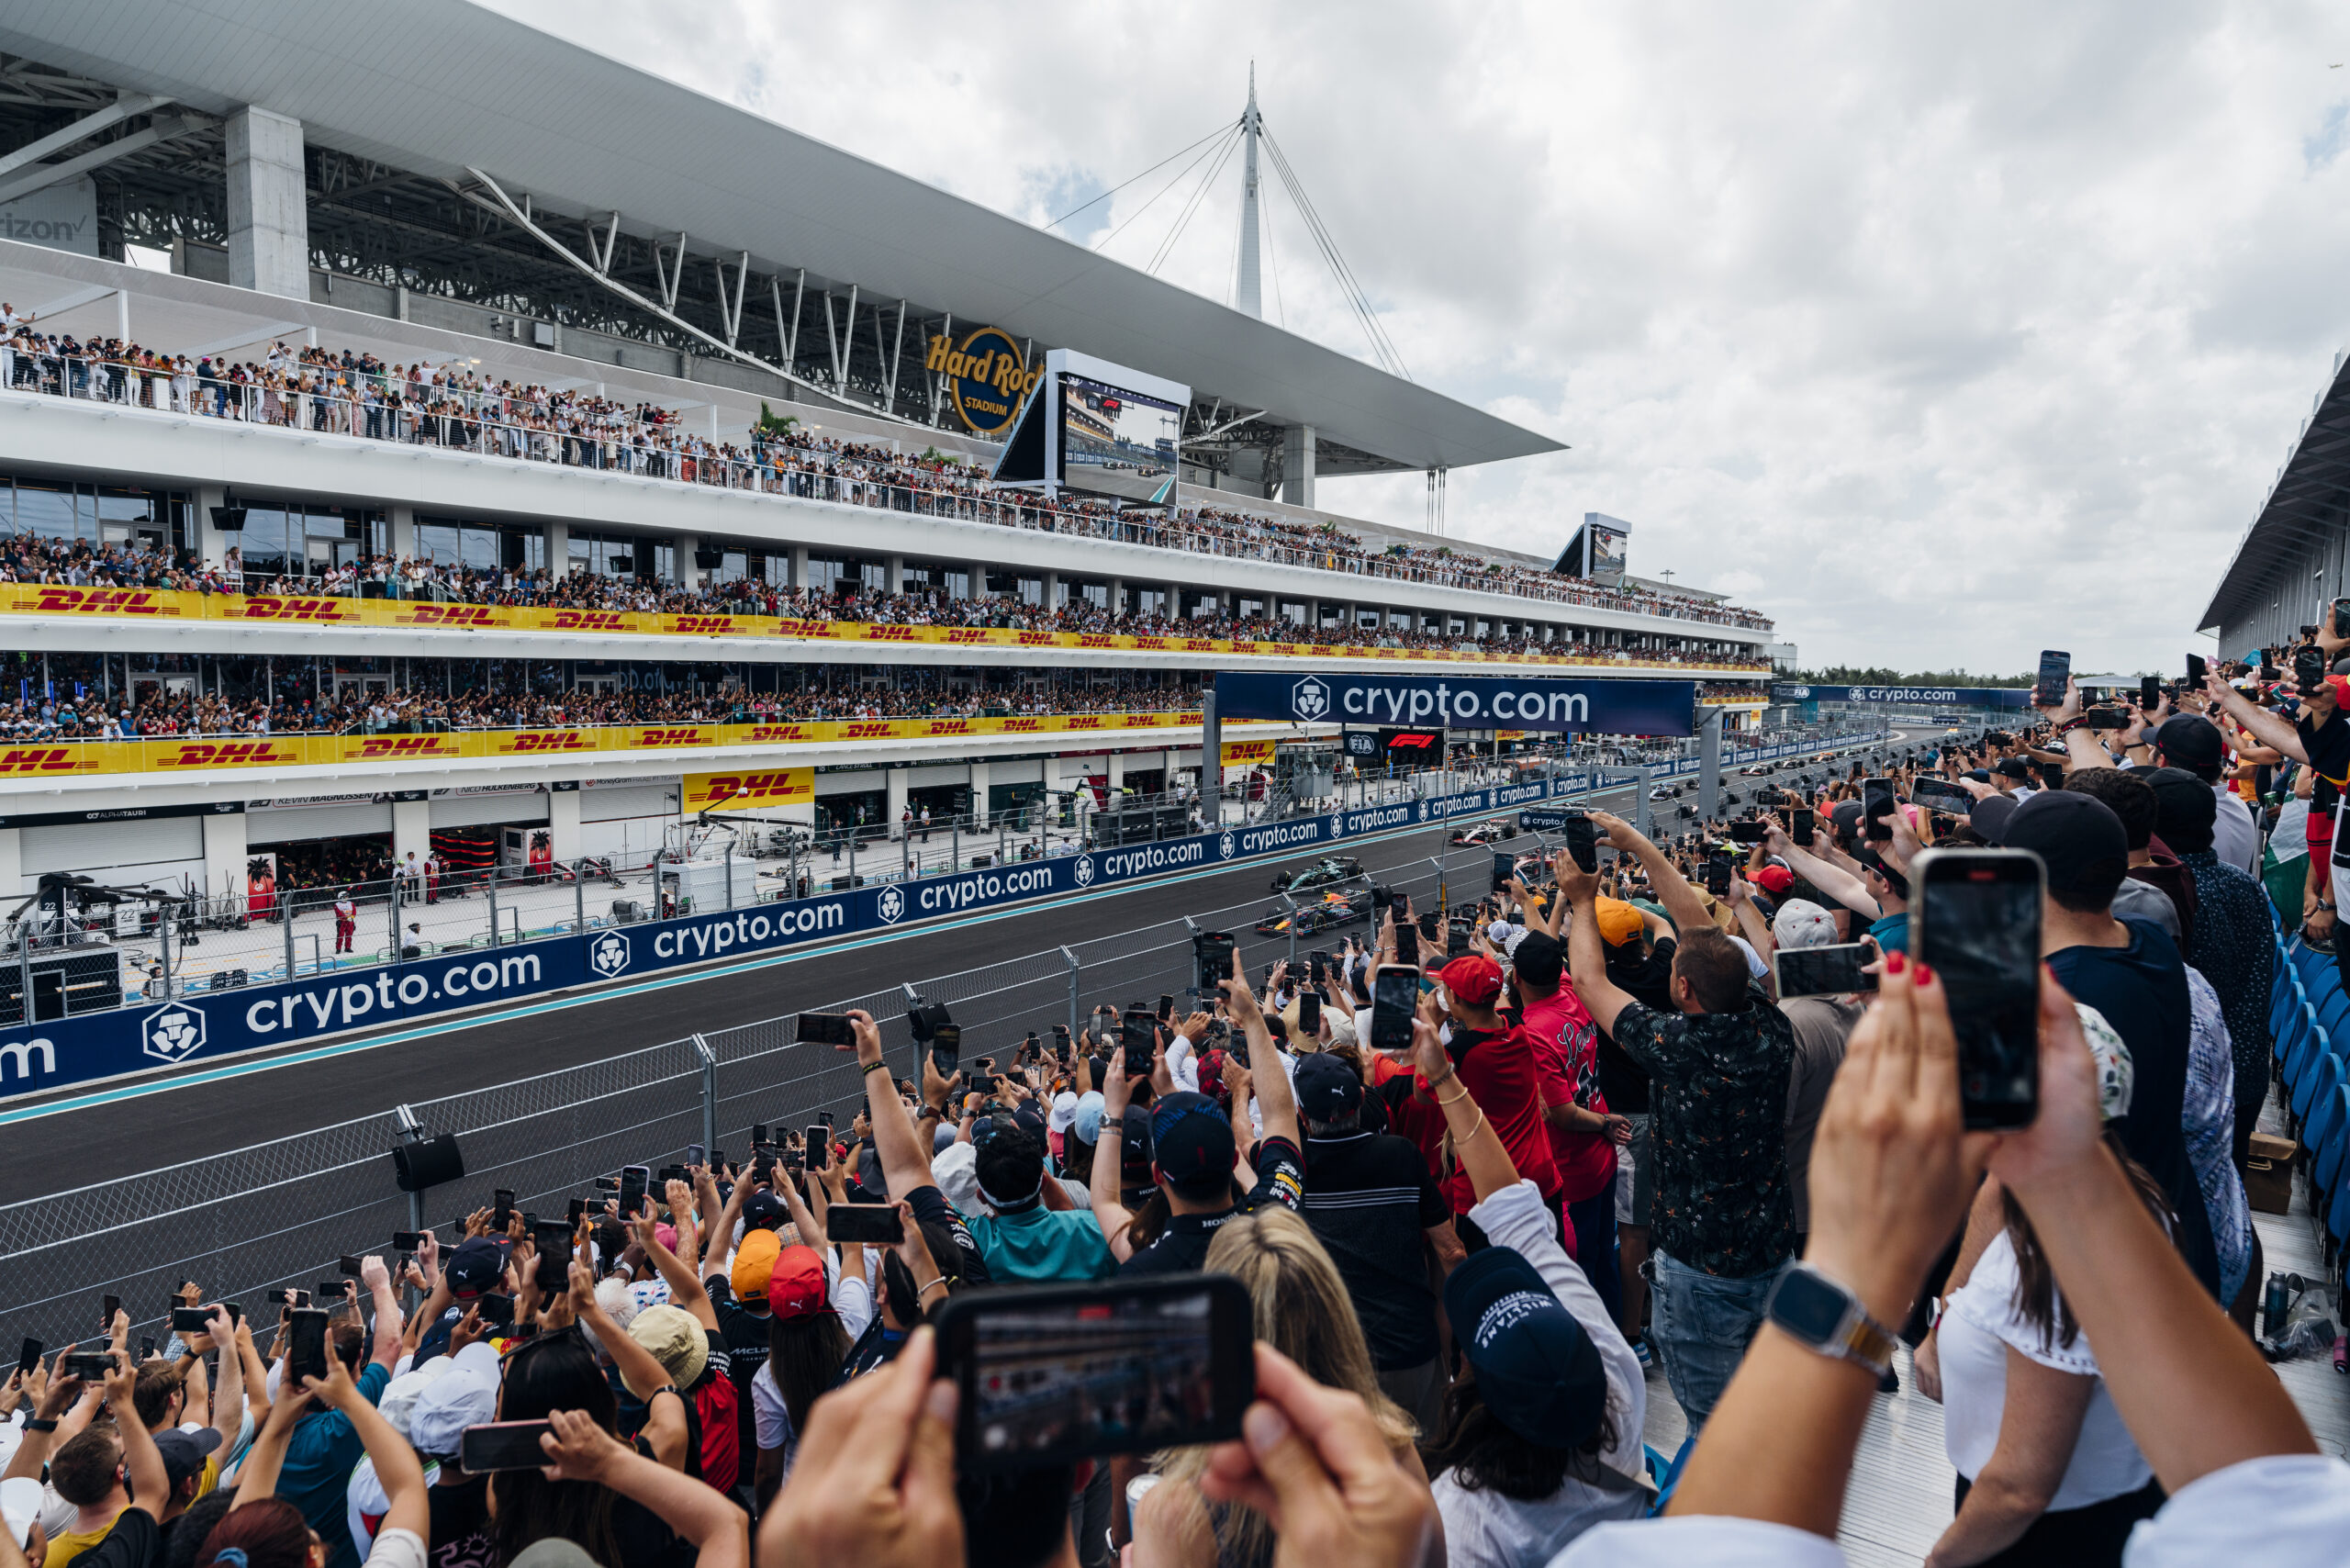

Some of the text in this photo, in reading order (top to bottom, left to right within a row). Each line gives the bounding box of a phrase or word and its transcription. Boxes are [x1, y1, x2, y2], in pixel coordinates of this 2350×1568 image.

[0, 213, 73, 241] izon
[926, 334, 996, 383] Hard
[964, 397, 1007, 417] STADIUM
[37, 589, 158, 613] DHL
[245, 598, 343, 620] DHL
[414, 606, 494, 625] DHL
[555, 612, 624, 630] DHL
[676, 617, 735, 633] DHL
[780, 621, 830, 637] DHL
[869, 626, 914, 640] DHL
[948, 630, 987, 642] DHL
[1019, 633, 1054, 645] DHL
[1080, 636, 1112, 647] DHL
[1136, 638, 1165, 649] DHL
[1187, 641, 1214, 651] DHL
[1232, 643, 1256, 653] DHL
[1274, 644, 1295, 654] DHL
[1311, 647, 1332, 655] DHL
[1347, 648, 1364, 656] DHL
[1869, 688, 1956, 702] crypto.com
[1344, 683, 1588, 723] crypto.com
[1004, 720, 1038, 731] DHL
[1068, 717, 1100, 728] DHL
[1126, 716, 1155, 726] DHL
[1179, 714, 1203, 724] DHL
[752, 727, 803, 740] DHL
[847, 724, 891, 737] DHL
[930, 722, 969, 734] DHL
[514, 733, 583, 750] DHL
[642, 729, 701, 745] DHL
[1351, 739, 1372, 750] FIA
[178, 744, 278, 765] DHL
[362, 738, 444, 756] DHL
[1230, 744, 1267, 759] DHL
[0, 750, 76, 772] HL
[461, 785, 481, 793] NICO
[706, 773, 794, 801] DHL
[1557, 777, 1587, 792] crypto.co
[248, 799, 272, 808] 20
[309, 793, 373, 802] MAGNUSSEN
[1500, 784, 1541, 803] crypto.com
[1433, 794, 1481, 817] crypto.com
[1348, 806, 1408, 831] crypto.com
[1532, 817, 1566, 827] crypto.c
[1243, 823, 1317, 851] crypto.com
[1105, 842, 1202, 875] crypto.com
[920, 868, 1052, 911] crypto.com
[121, 909, 135, 920] 22
[654, 902, 843, 959] crypto.com
[246, 954, 541, 1034] crypto.com
[1138, 1185, 1156, 1193] HON
[1269, 1187, 1297, 1210] Mobil
[1202, 1211, 1239, 1228] HONDA
